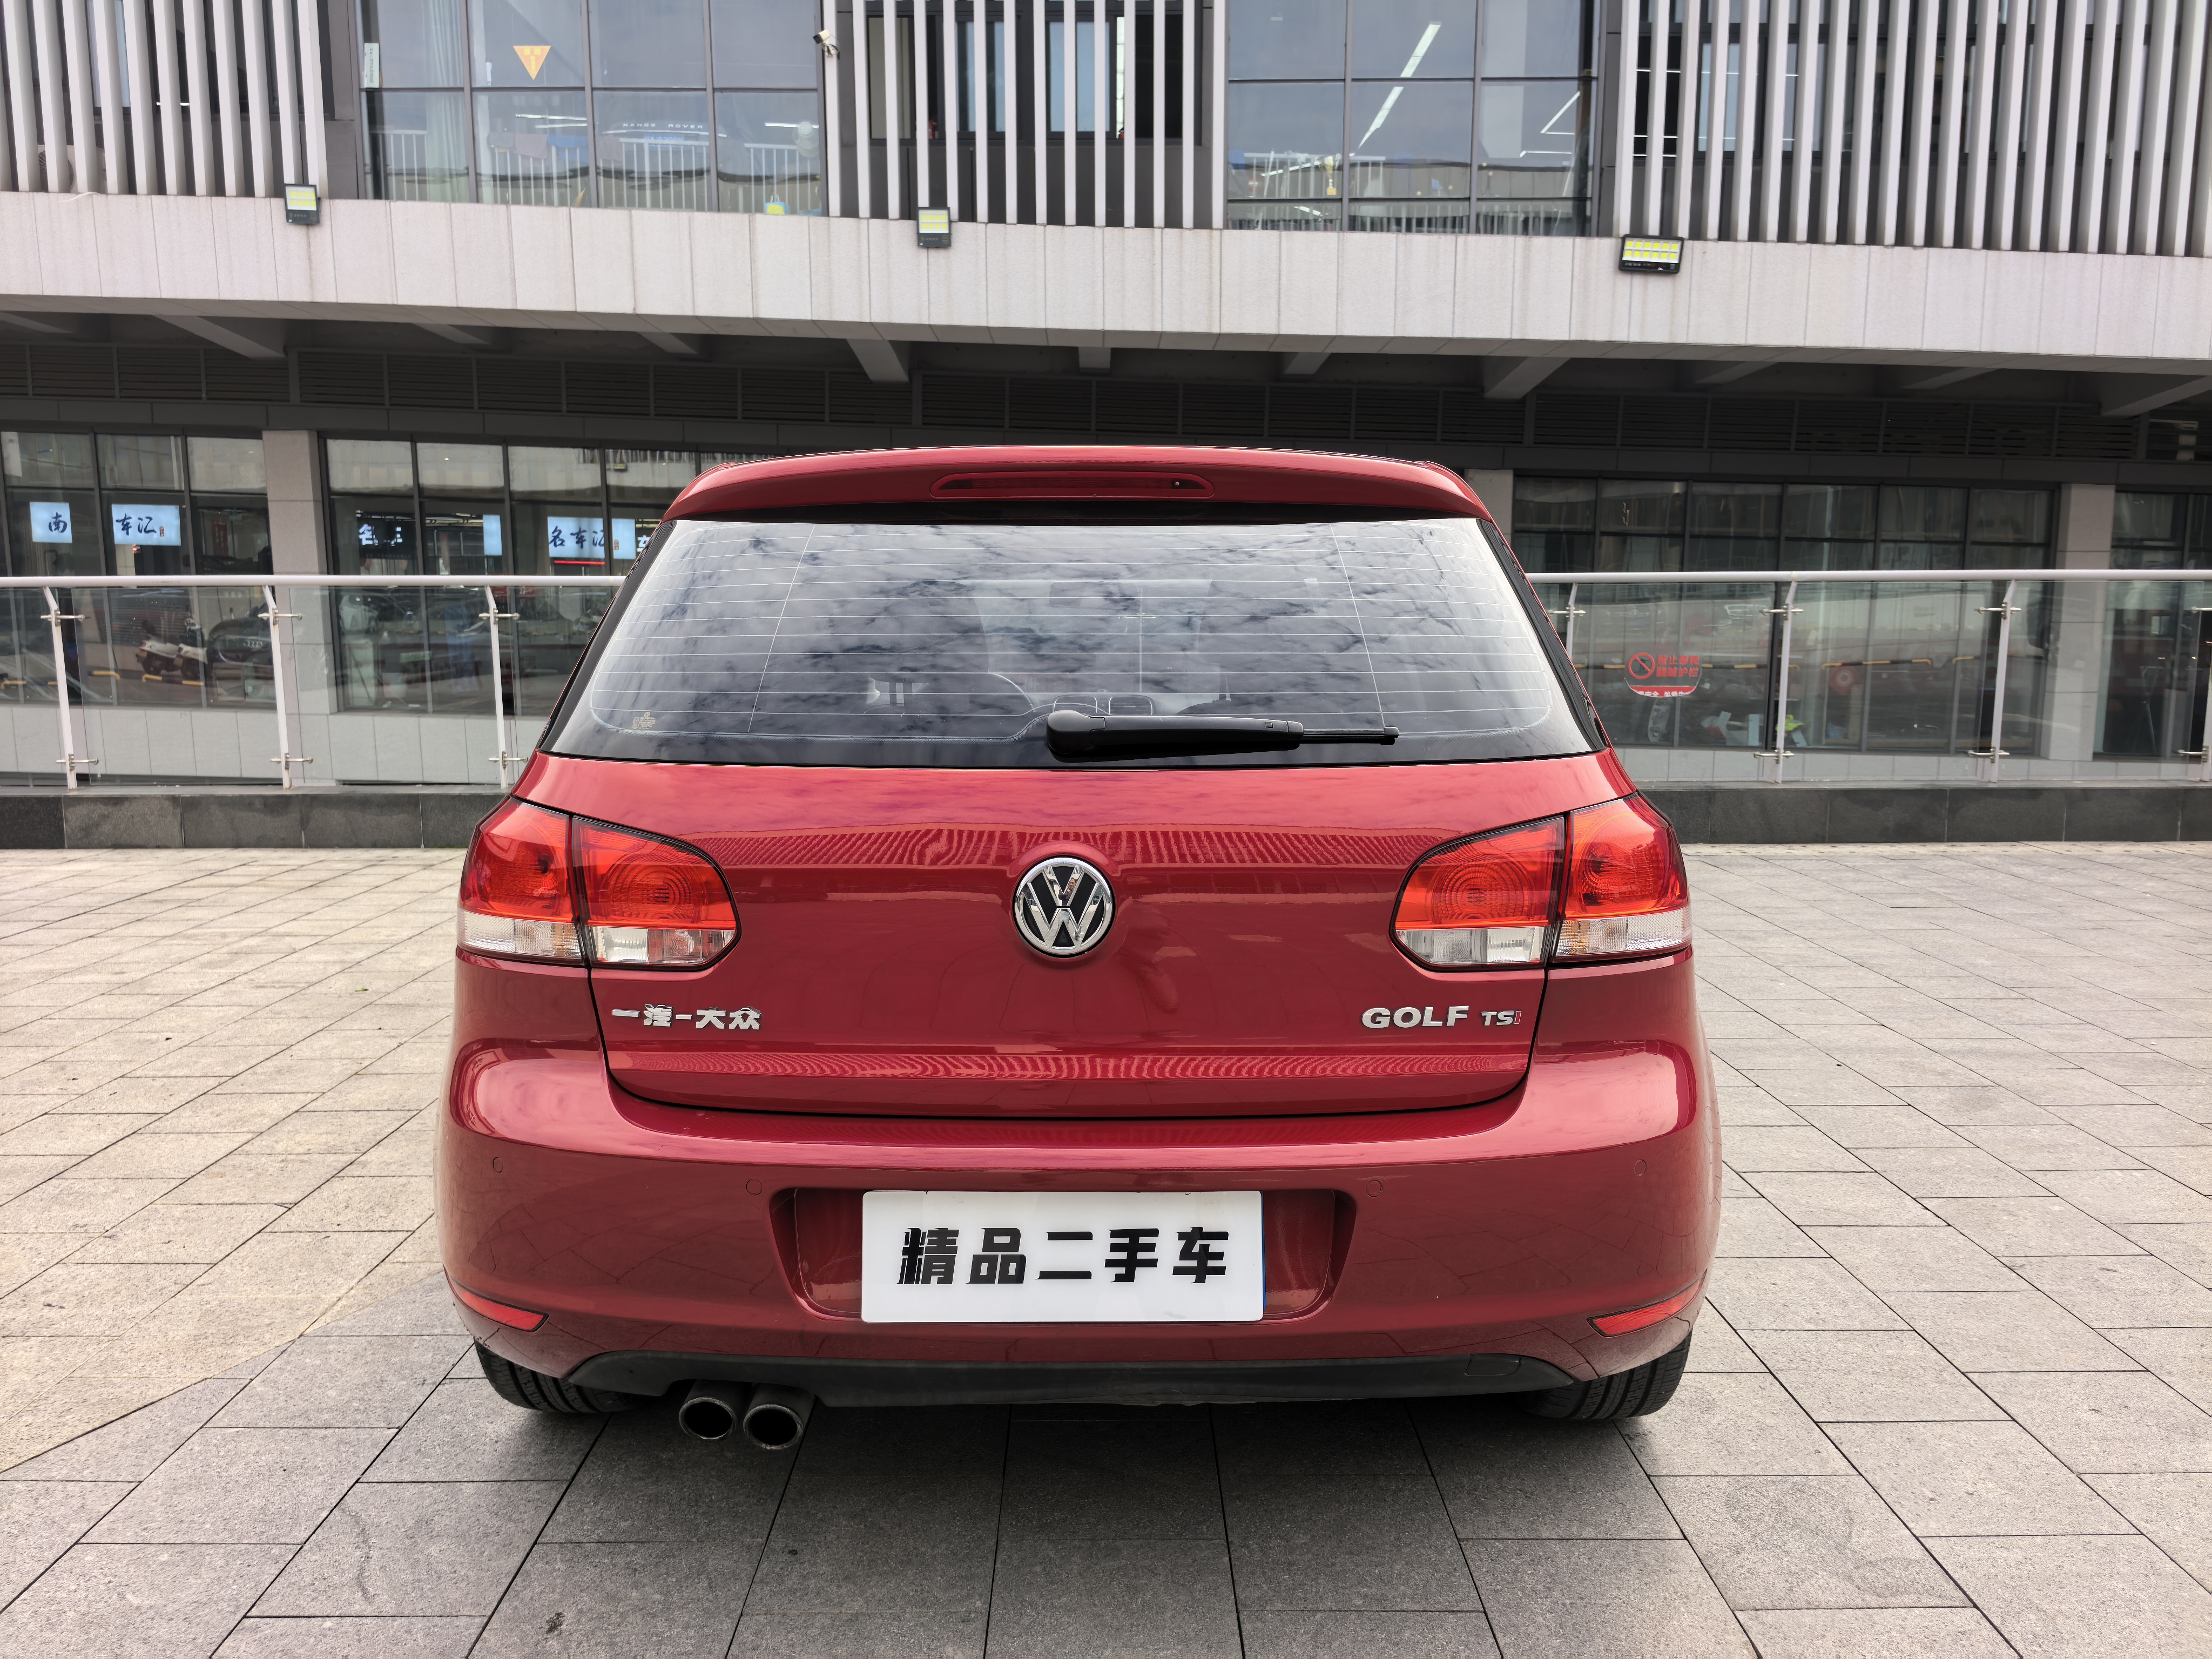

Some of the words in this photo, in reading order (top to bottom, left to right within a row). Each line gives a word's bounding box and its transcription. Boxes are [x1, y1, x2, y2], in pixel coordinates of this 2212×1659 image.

[49, 512, 67, 534] 南
[1362, 1006, 1469, 1029] GOLF
[1481, 1010, 1521, 1026] TSI
[894, 1226, 1230, 1285] 精品二手车
